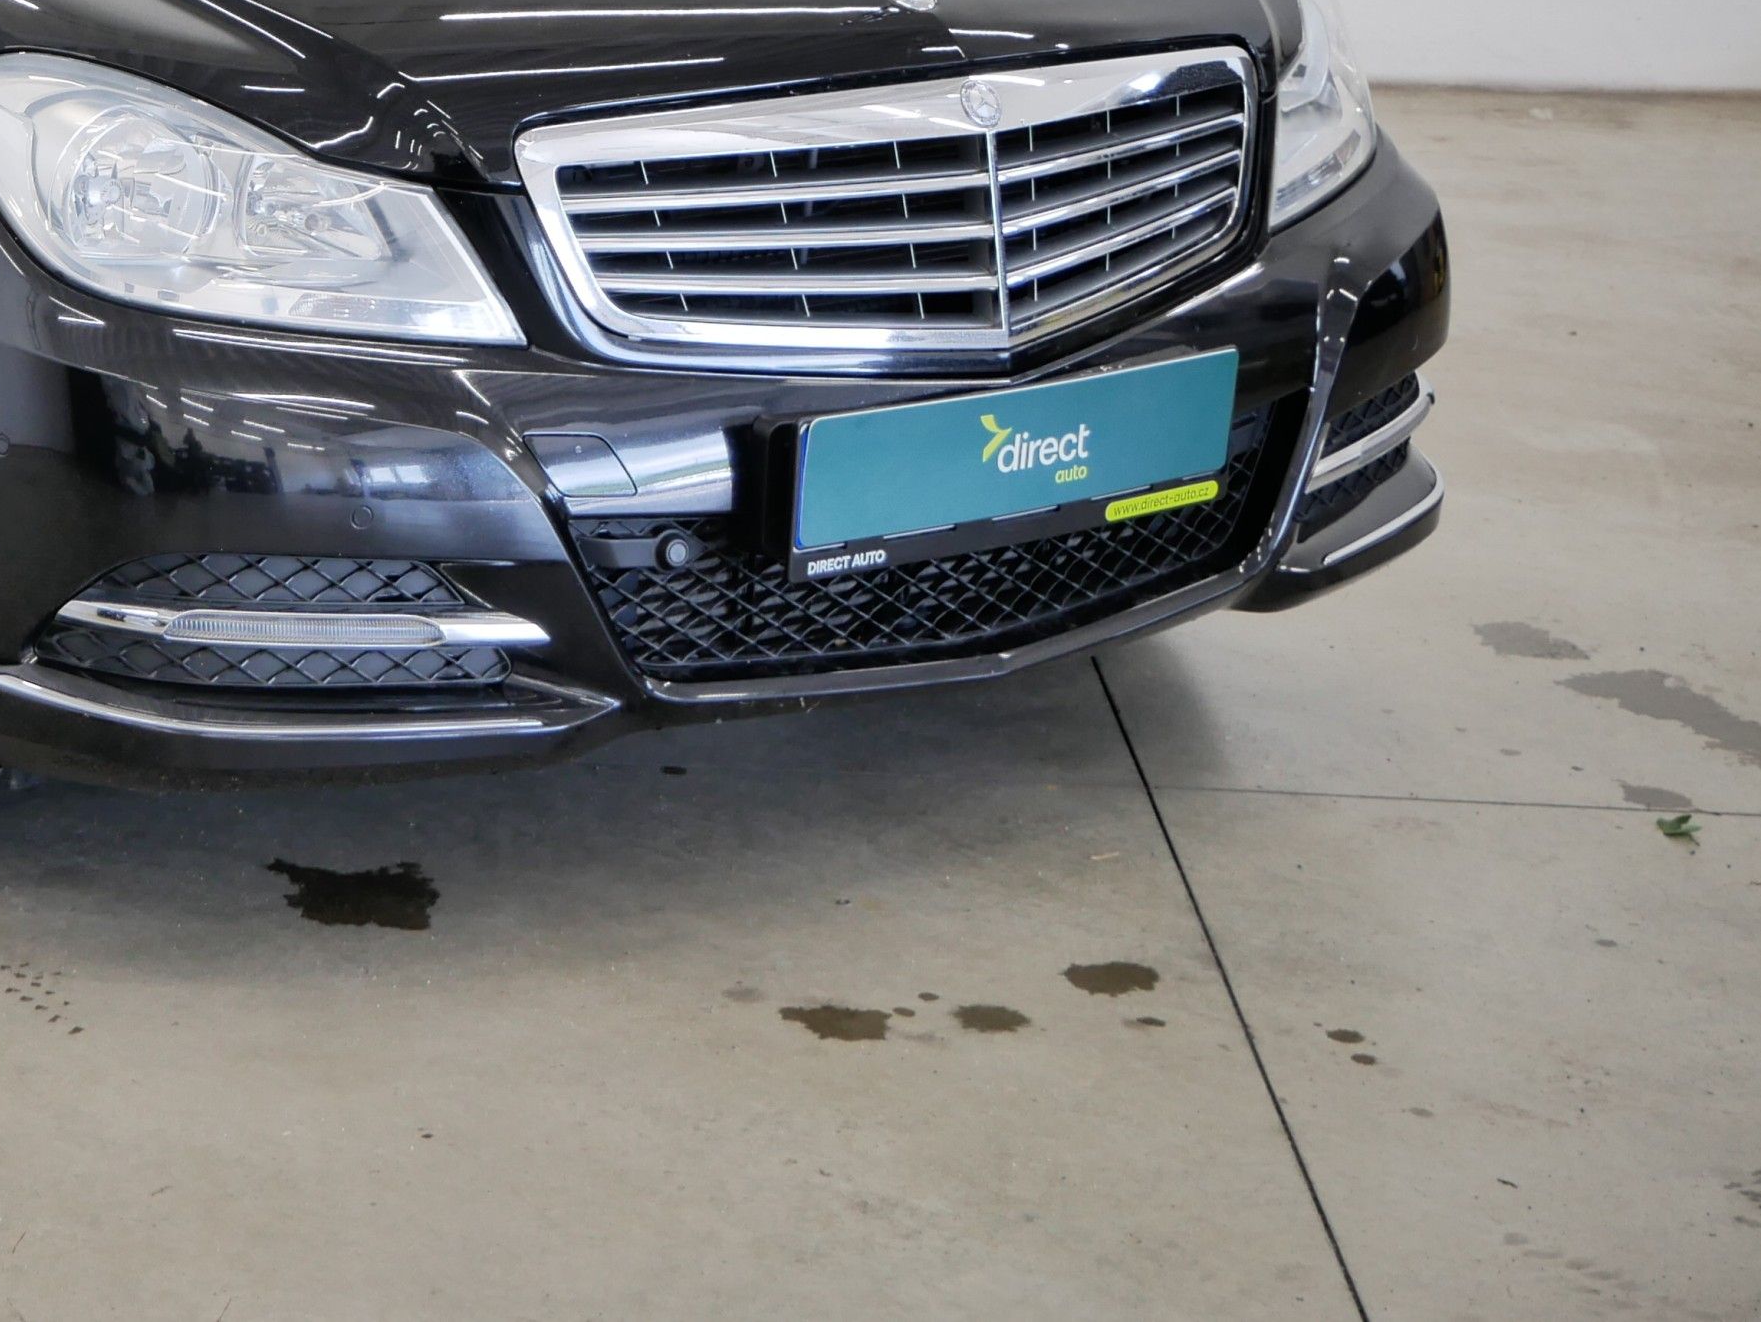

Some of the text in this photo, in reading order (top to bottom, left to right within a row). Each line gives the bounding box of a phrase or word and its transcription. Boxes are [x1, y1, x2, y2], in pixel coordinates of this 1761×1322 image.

[997, 423, 1090, 474] direct
[1055, 464, 1088, 483] auto
[1113, 486, 1210, 517] www.direct-auto.cz
[807, 549, 887, 576] DIRECT AUTO
